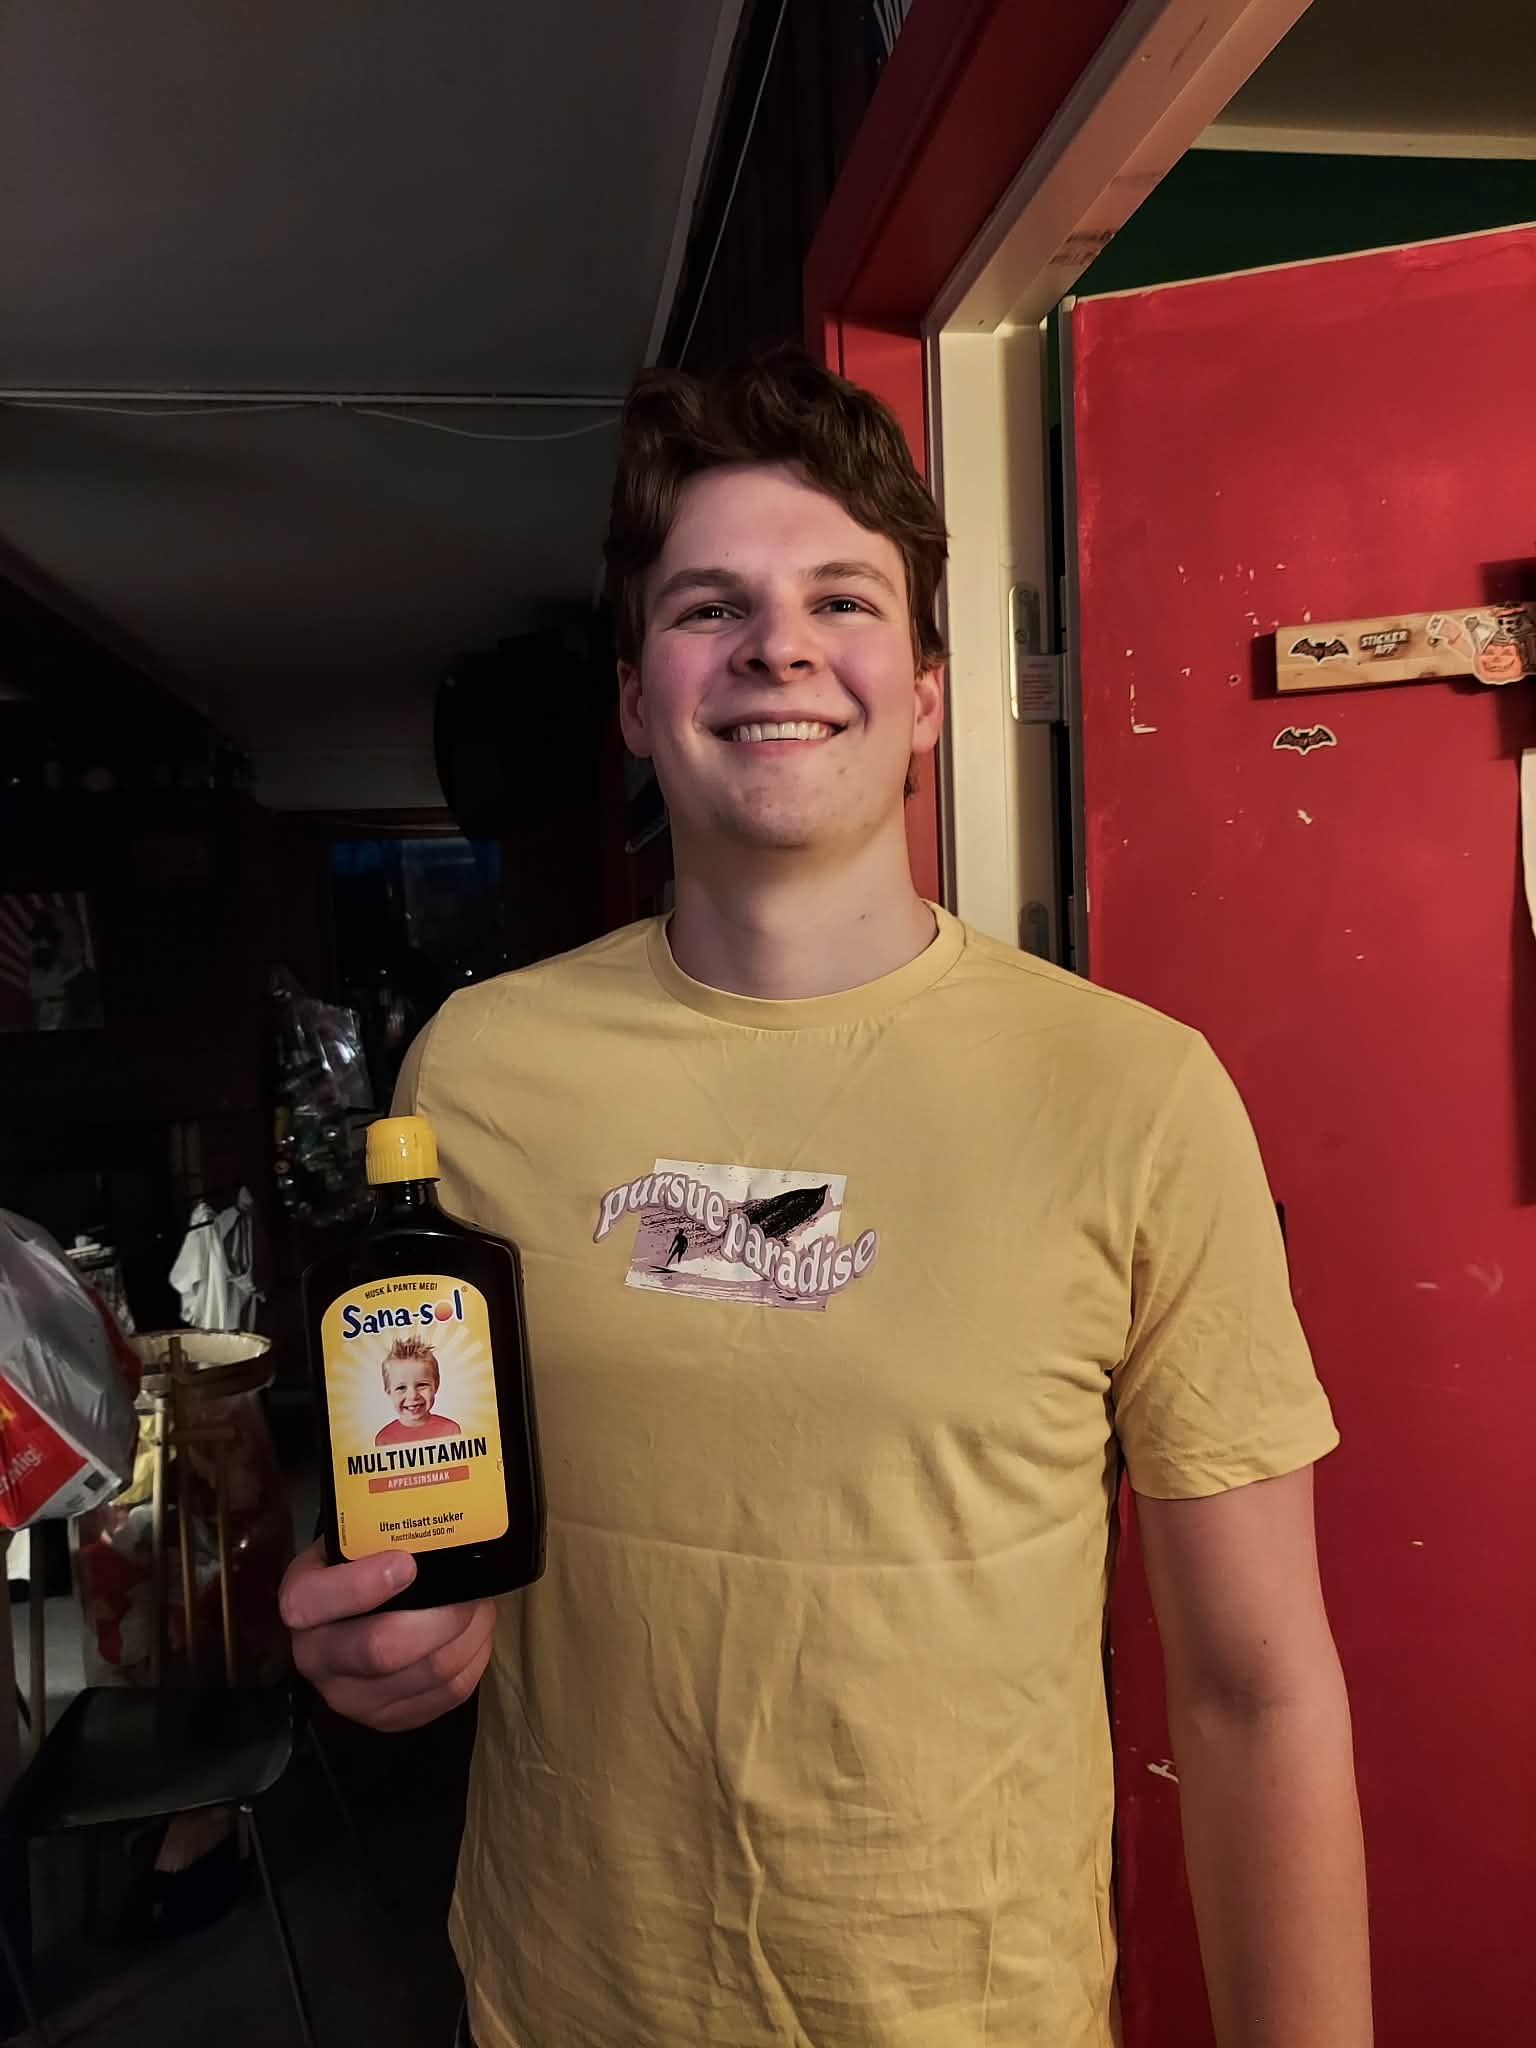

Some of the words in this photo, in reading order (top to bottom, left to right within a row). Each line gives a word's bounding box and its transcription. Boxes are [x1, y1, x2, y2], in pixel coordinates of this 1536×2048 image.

[593, 1172, 728, 1243] pursue
[722, 1210, 877, 1294] paradise
[365, 1287, 384, 1299] HUSK
[394, 1283, 417, 1293] PANTE
[419, 1283, 438, 1291] MEG!
[343, 1289, 462, 1338] Sana-sol
[347, 1437, 487, 1475] MULTIVITAMIN
[388, 1471, 450, 1489] APPELSINSMAK
[380, 1521, 400, 1532] Uten
[402, 1517, 431, 1529] tilsatt
[432, 1512, 464, 1524] sukker
[391, 1530, 431, 1542] Kosttilskudd
[432, 1527, 445, 1536] 500
[446, 1526, 455, 1534] ml
